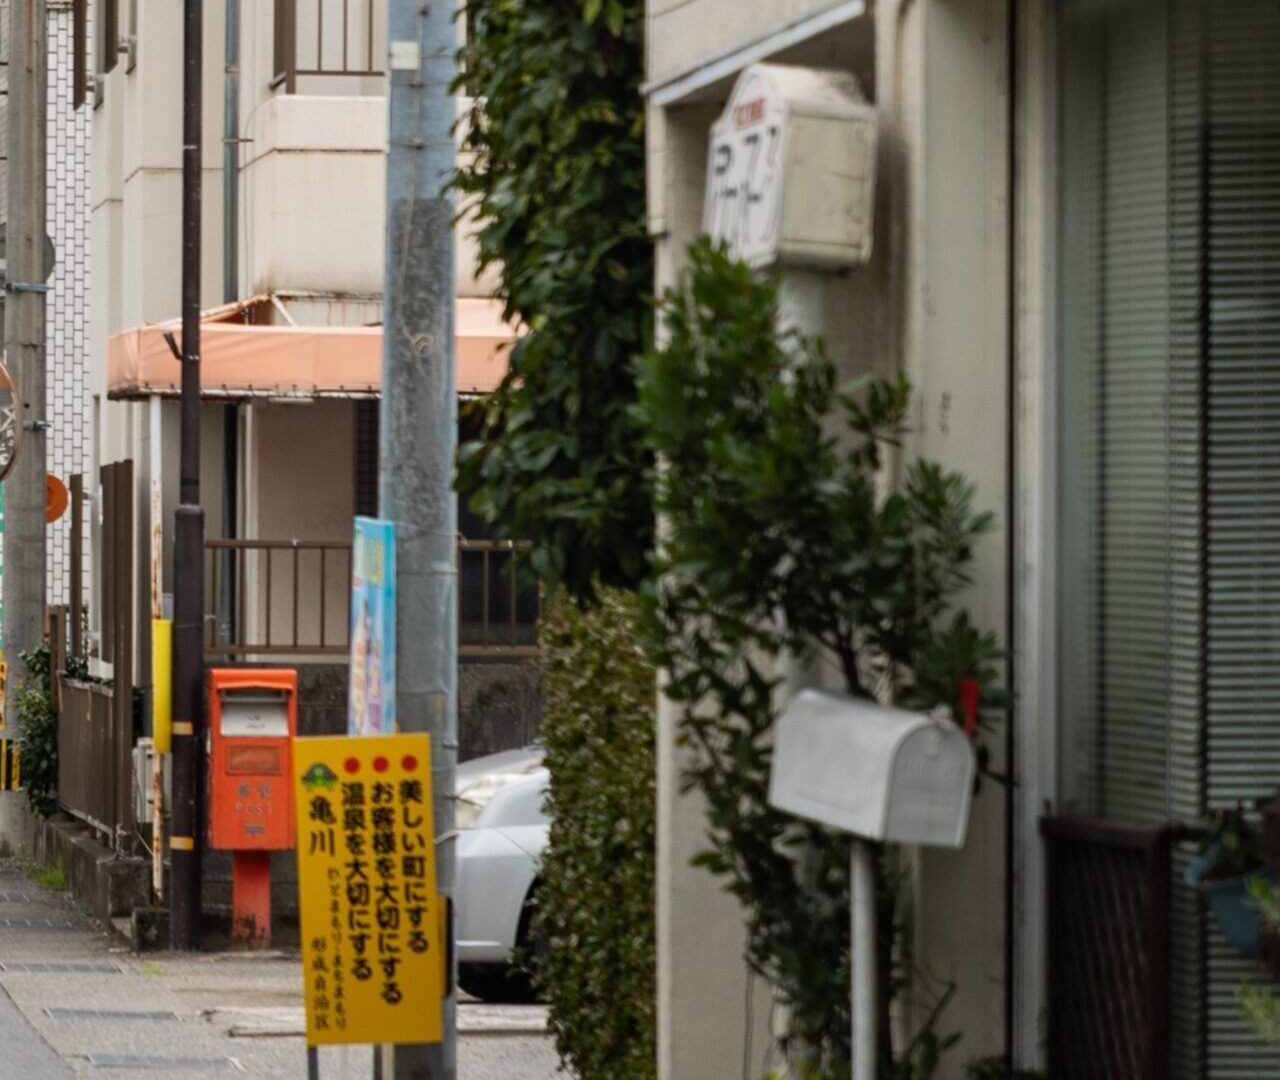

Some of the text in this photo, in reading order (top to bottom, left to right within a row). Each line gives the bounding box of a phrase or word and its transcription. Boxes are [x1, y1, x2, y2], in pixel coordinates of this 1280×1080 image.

[309, 795, 337, 857] 亀川
[341, 782, 372, 981] 温泉を大切にする
[371, 782, 403, 1005] お客様を大切にする
[399, 780, 429, 954] 美しい町にする
